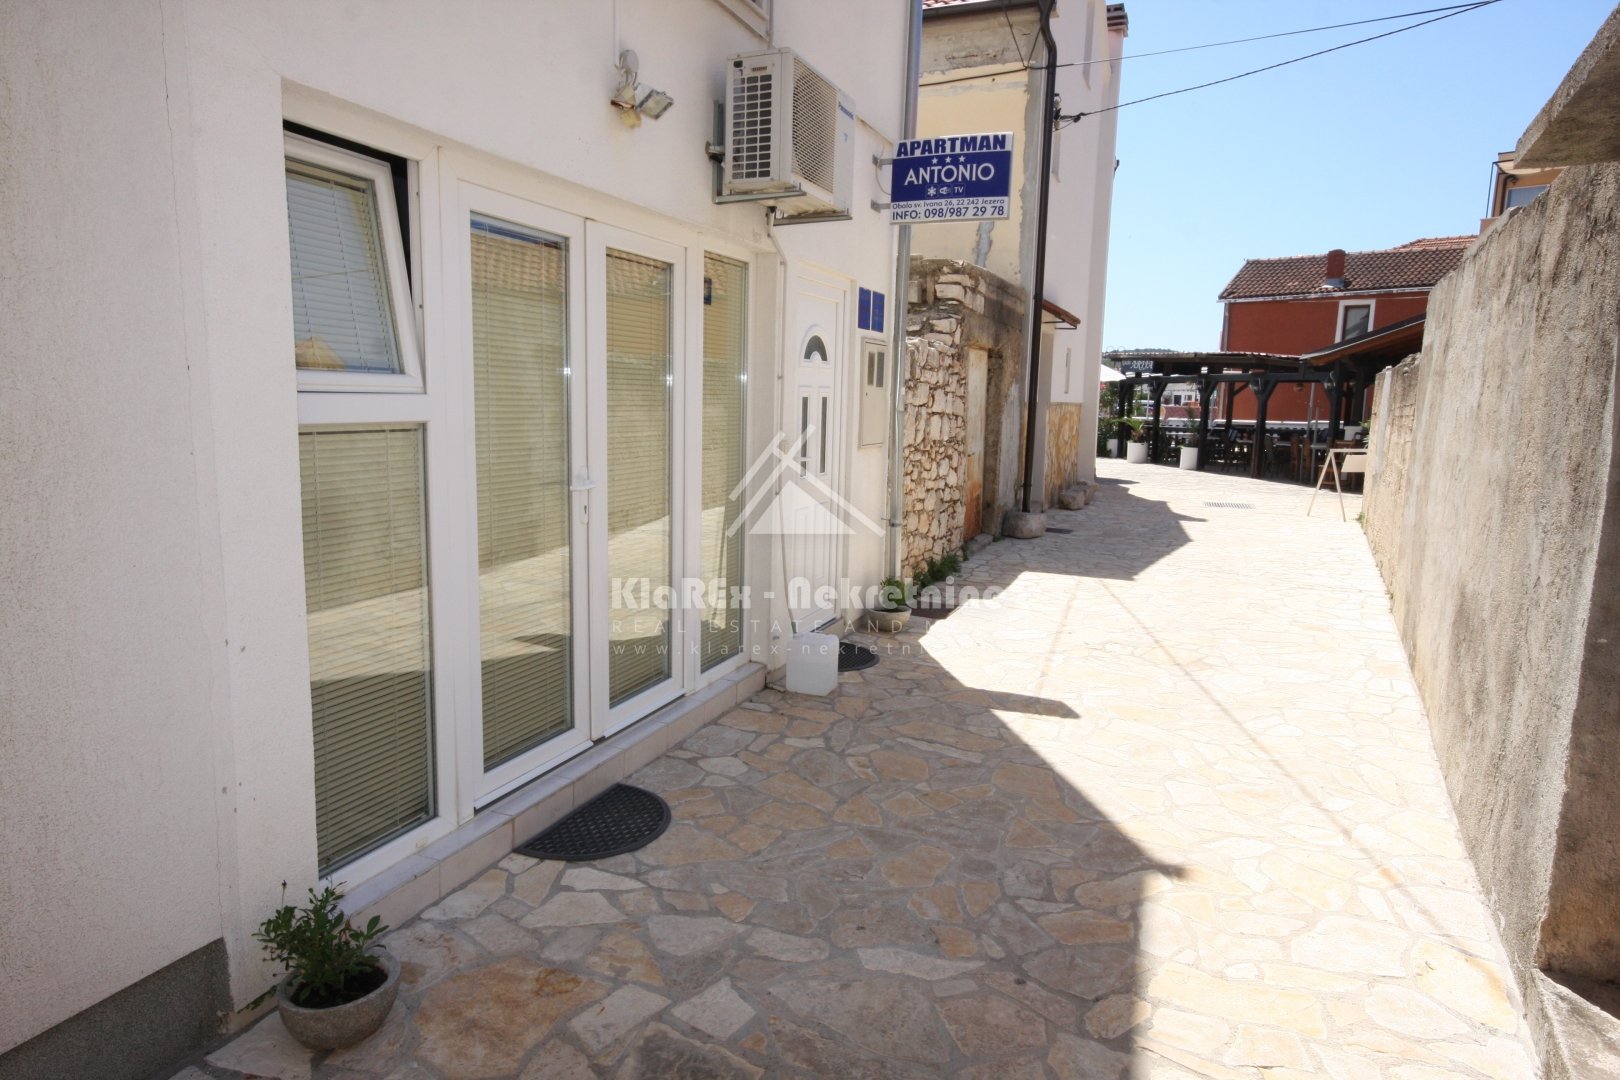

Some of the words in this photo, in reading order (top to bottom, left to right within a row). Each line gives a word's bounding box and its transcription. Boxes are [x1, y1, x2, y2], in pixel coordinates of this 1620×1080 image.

[896, 134, 1007, 158] APARTMAN
[904, 163, 995, 186] ANTONIO
[892, 209, 921, 220] INFO:
[924, 206, 969, 219] 098/987
[972, 206, 987, 217] 29
[990, 205, 1005, 216] 78
[923, 200, 943, 208] Ivana
[944, 199, 955, 207] 26,
[981, 198, 1005, 206] Jezera
